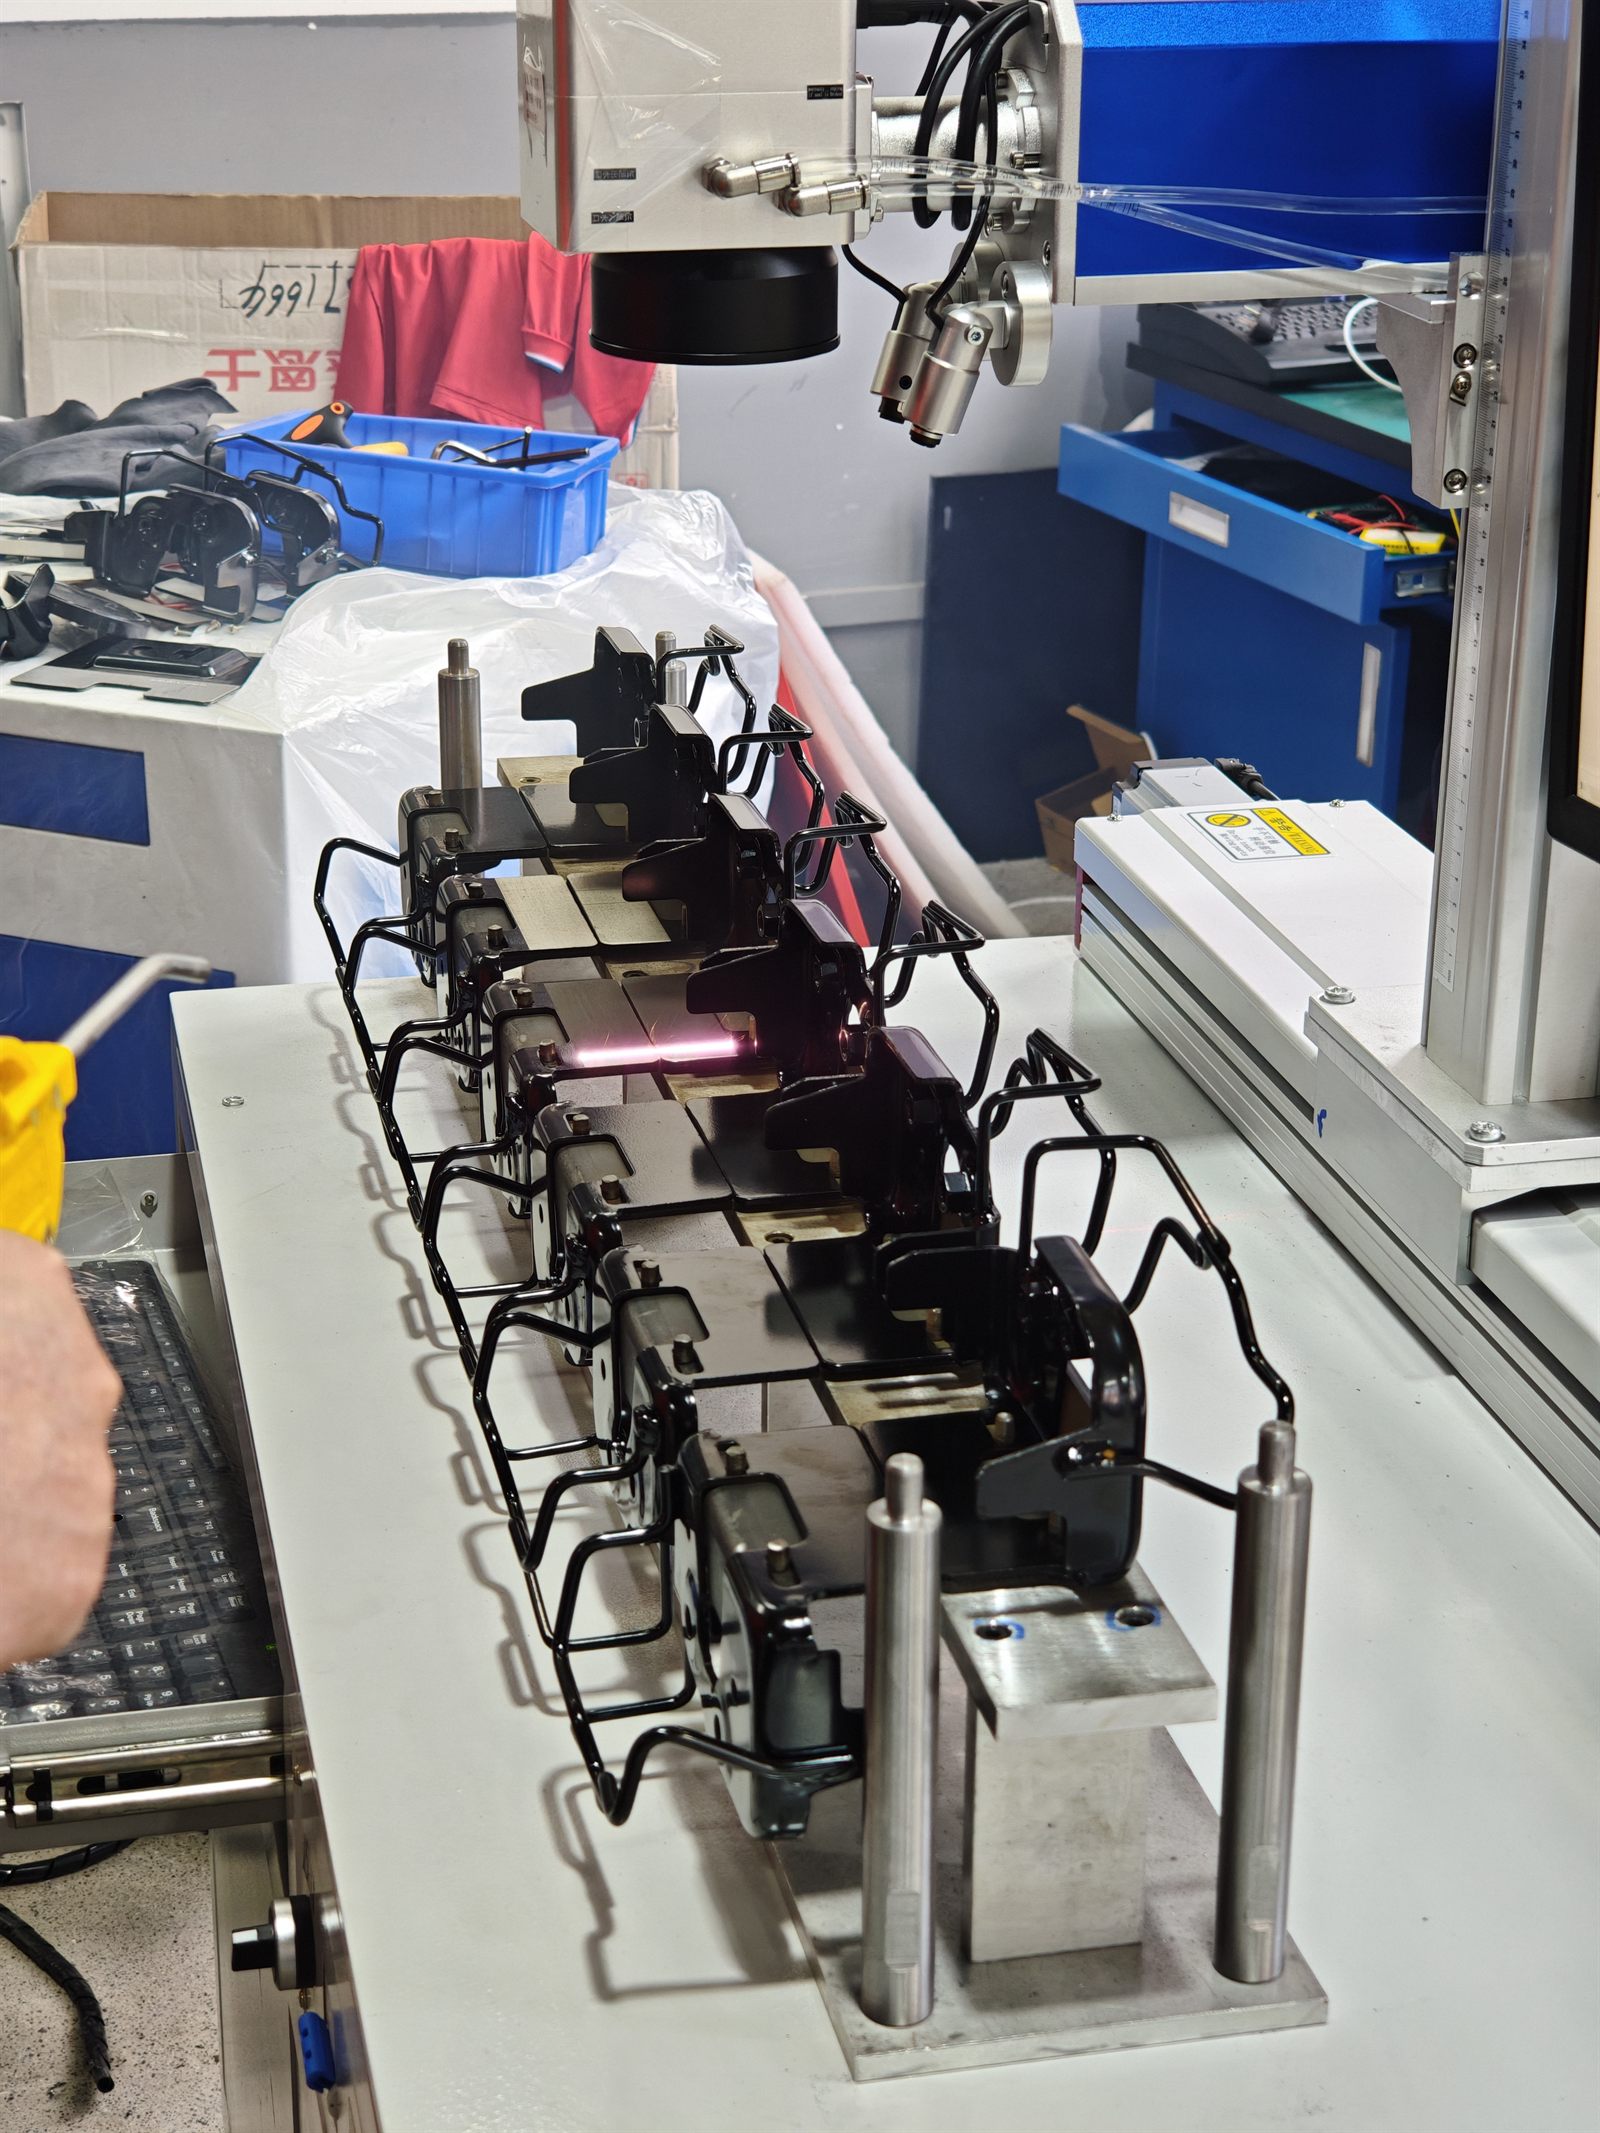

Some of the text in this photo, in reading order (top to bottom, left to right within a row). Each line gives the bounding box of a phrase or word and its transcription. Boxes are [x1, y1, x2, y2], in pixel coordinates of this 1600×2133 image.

[238, 260, 351, 319] 71664
[195, 1499, 206, 1509] F11
[147, 1506, 163, 1533] Backspace
[204, 1520, 214, 1531] F12
[168, 1555, 179, 1569] Insert
[177, 1577, 188, 1592] Home
[127, 1588, 137, 1599] End
[178, 1605, 187, 1614] Up
[186, 1601, 196, 1615] Page
[134, 1609, 145, 1623] Page
